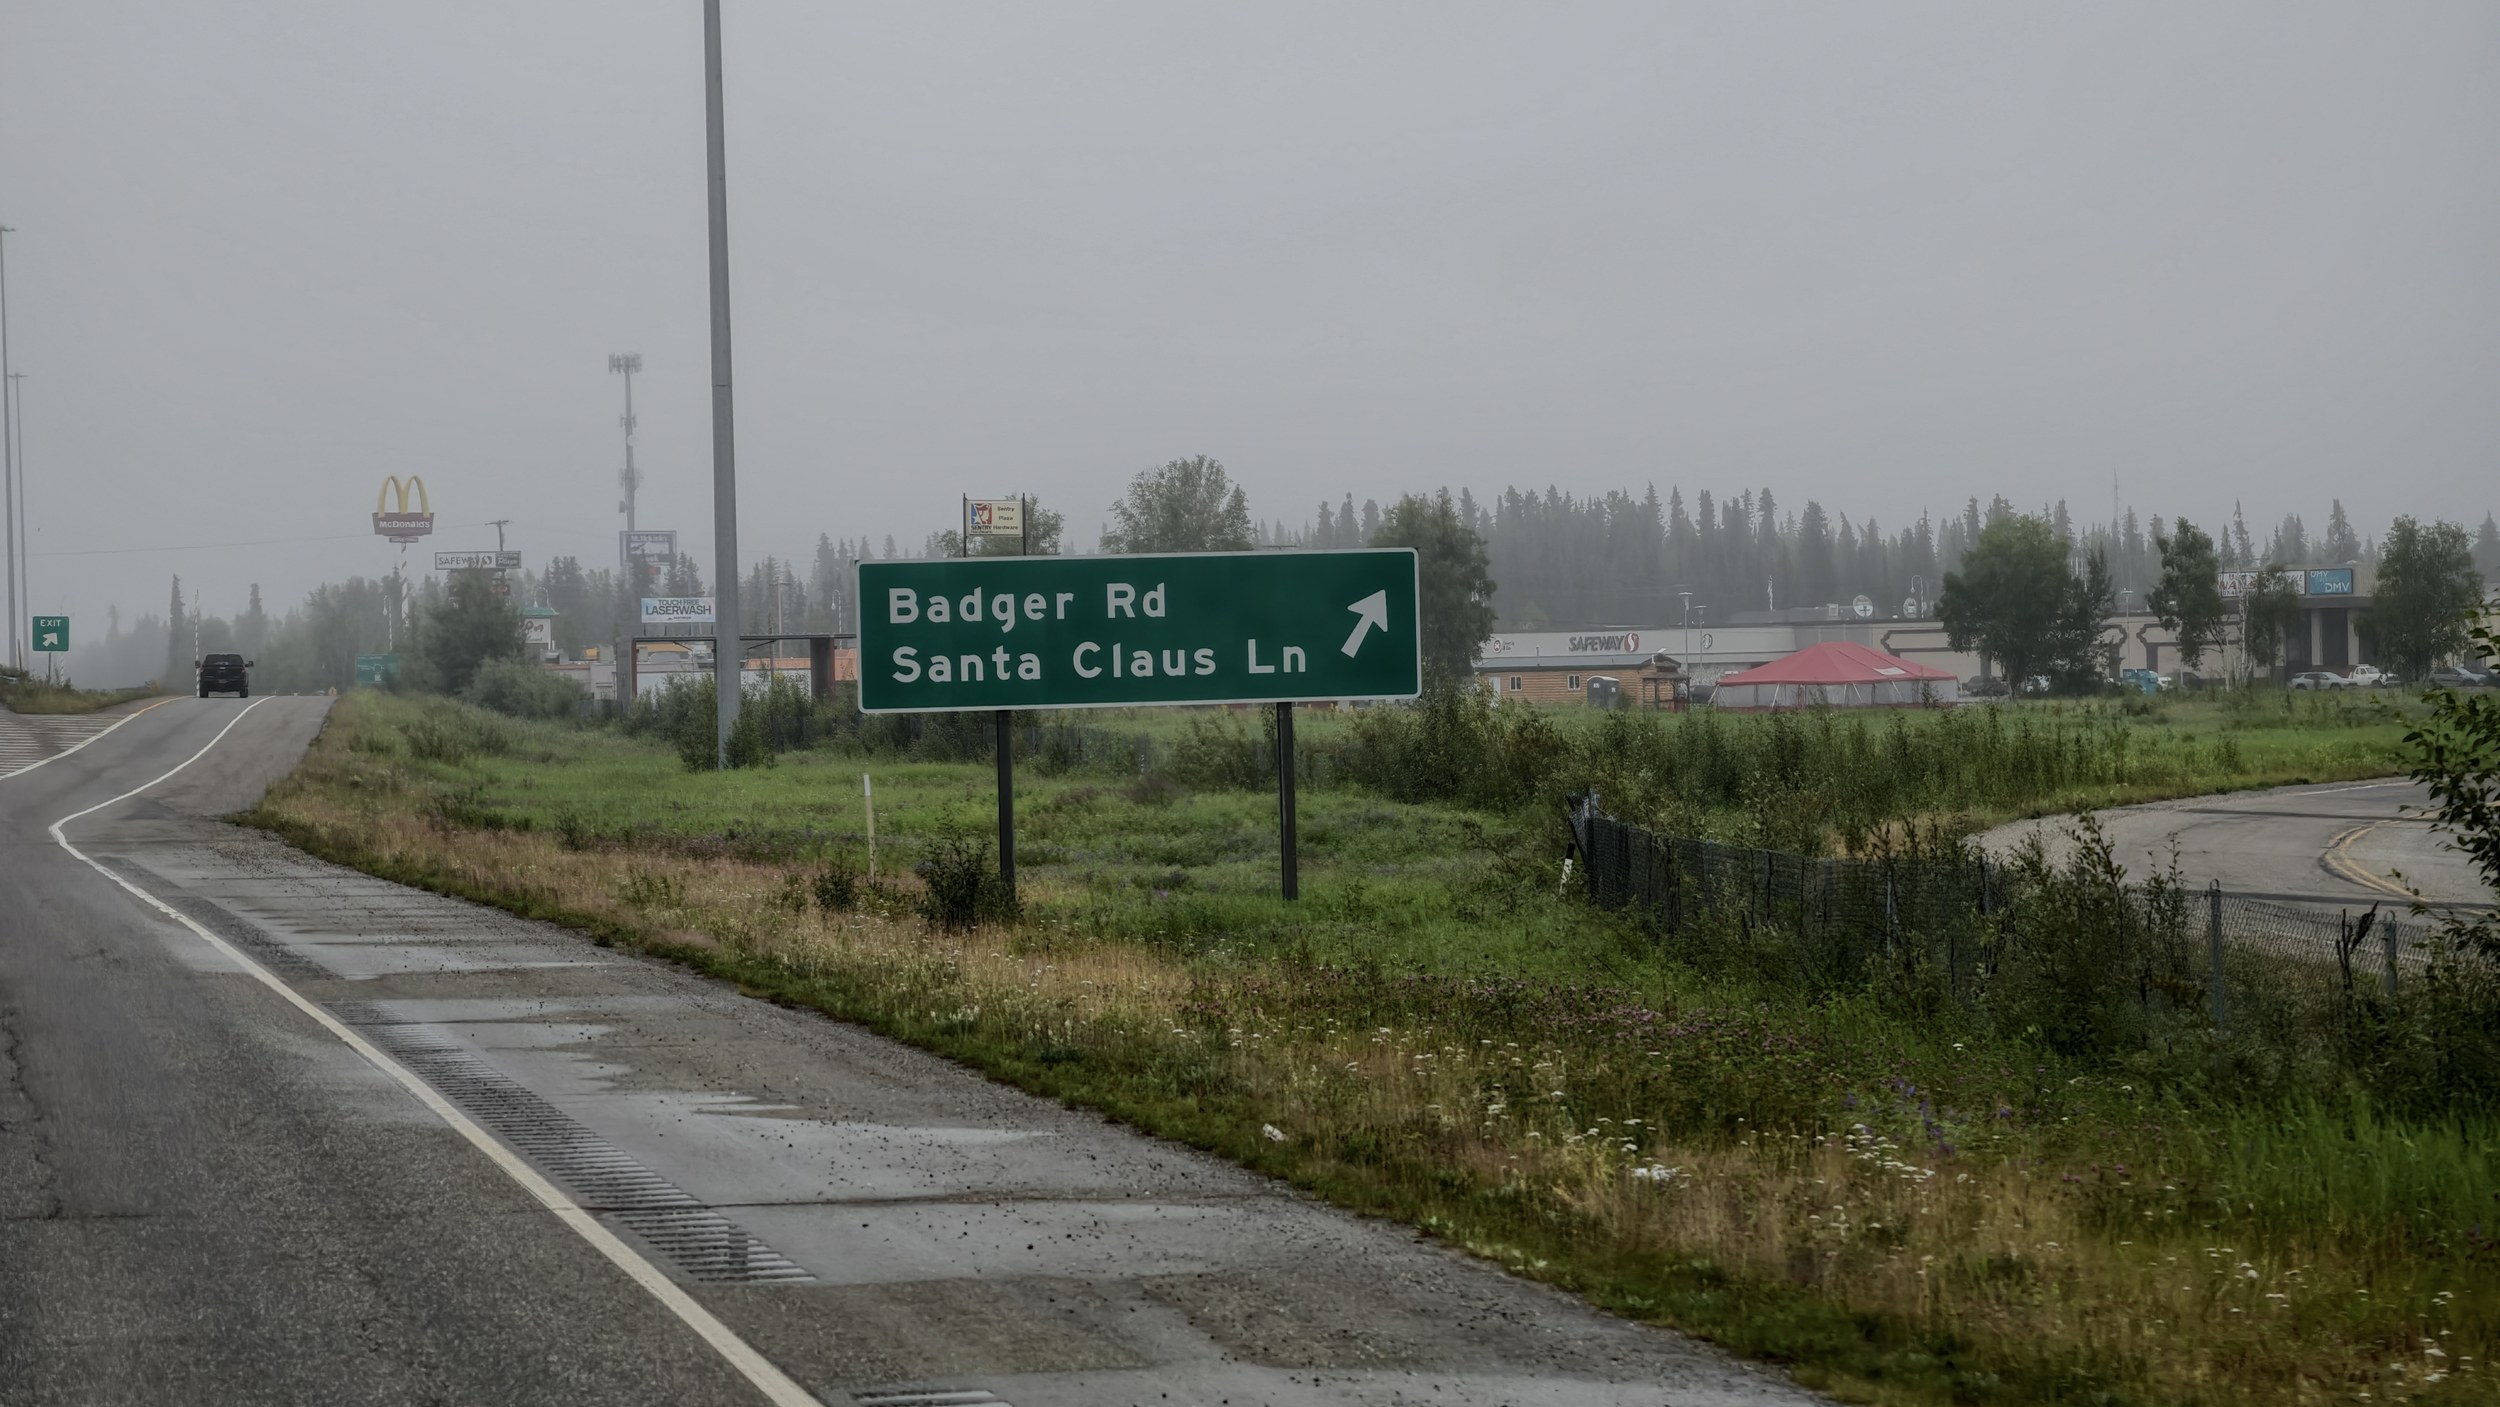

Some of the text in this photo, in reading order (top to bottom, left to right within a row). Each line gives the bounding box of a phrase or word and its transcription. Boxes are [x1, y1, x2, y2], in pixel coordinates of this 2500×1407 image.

[379, 520, 431, 529] McDonald's
[2325, 582, 2350, 593] DMV
[645, 605, 712, 615] LASERWASH
[889, 582, 1166, 634] Badger Rd
[40, 619, 62, 628] EXIT
[1568, 635, 1625, 653] SAFEWAY
[892, 639, 1307, 684] Santa Claus Ln
